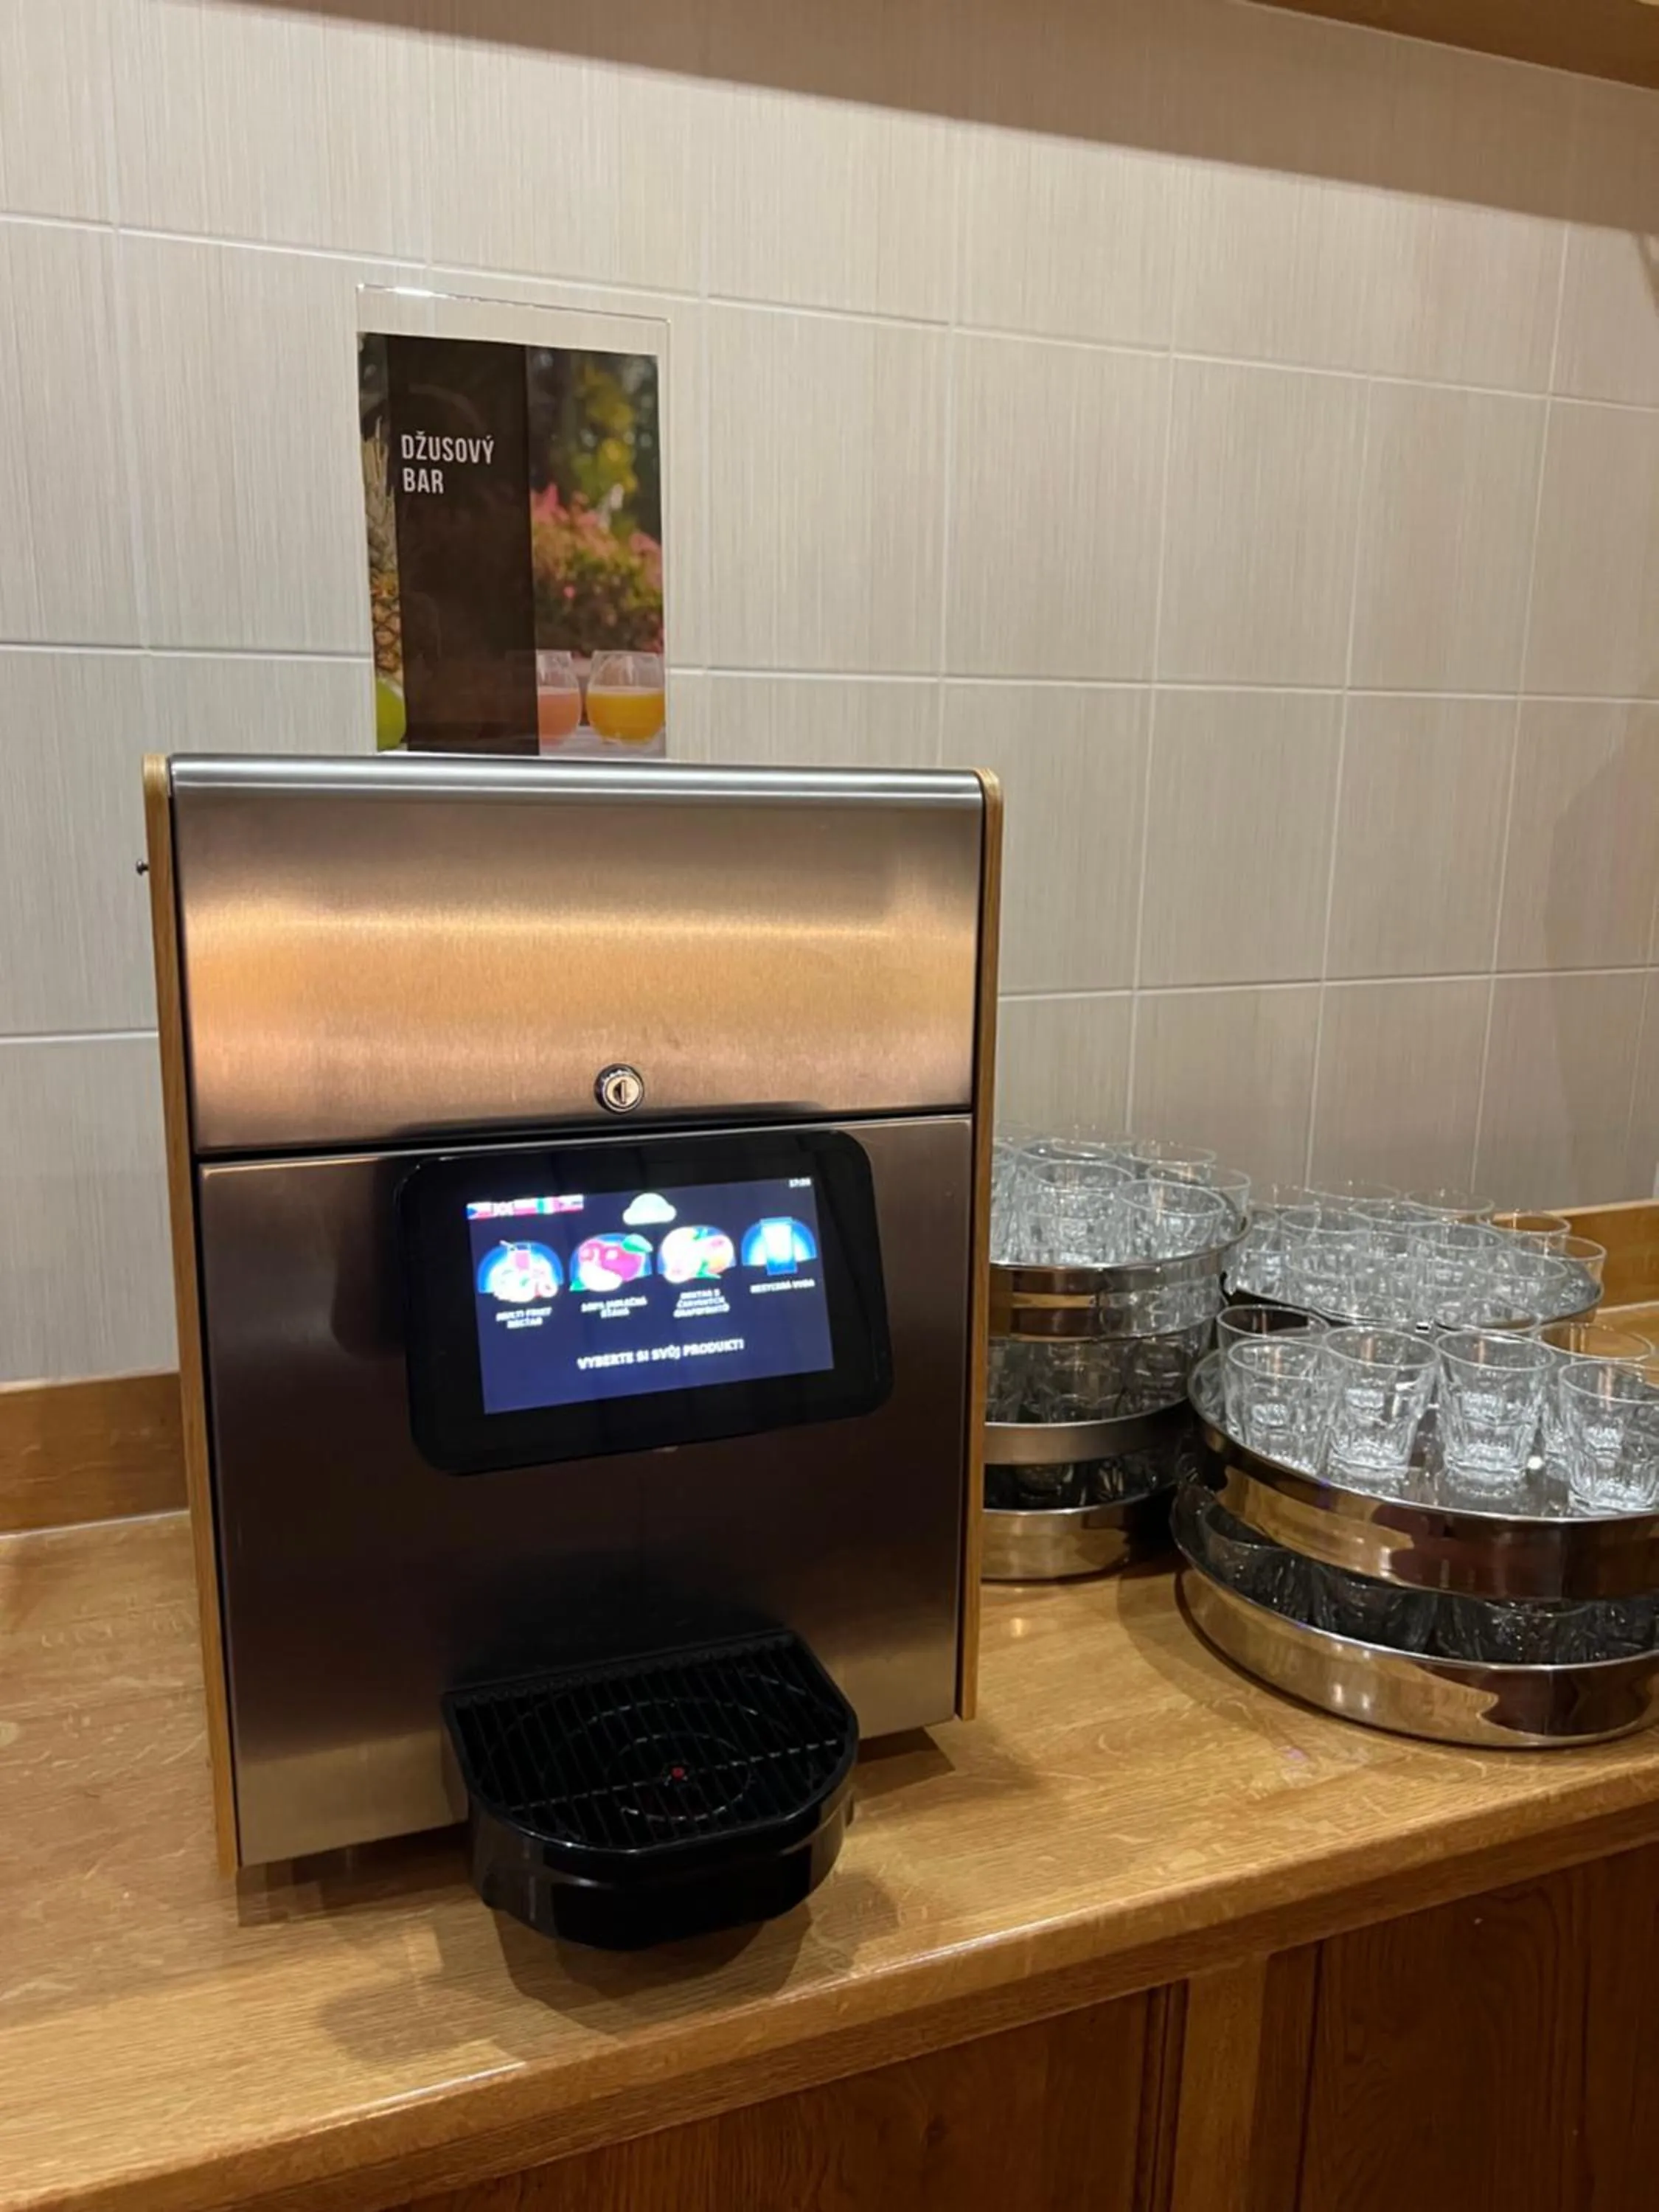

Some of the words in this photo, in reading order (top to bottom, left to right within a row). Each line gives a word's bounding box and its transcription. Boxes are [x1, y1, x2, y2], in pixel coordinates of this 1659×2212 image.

[401, 430, 495, 465] DŽUSOVÝ
[403, 467, 444, 494] BAR
[577, 1351, 634, 1369] VYBERTE
[636, 1349, 649, 1363] SI
